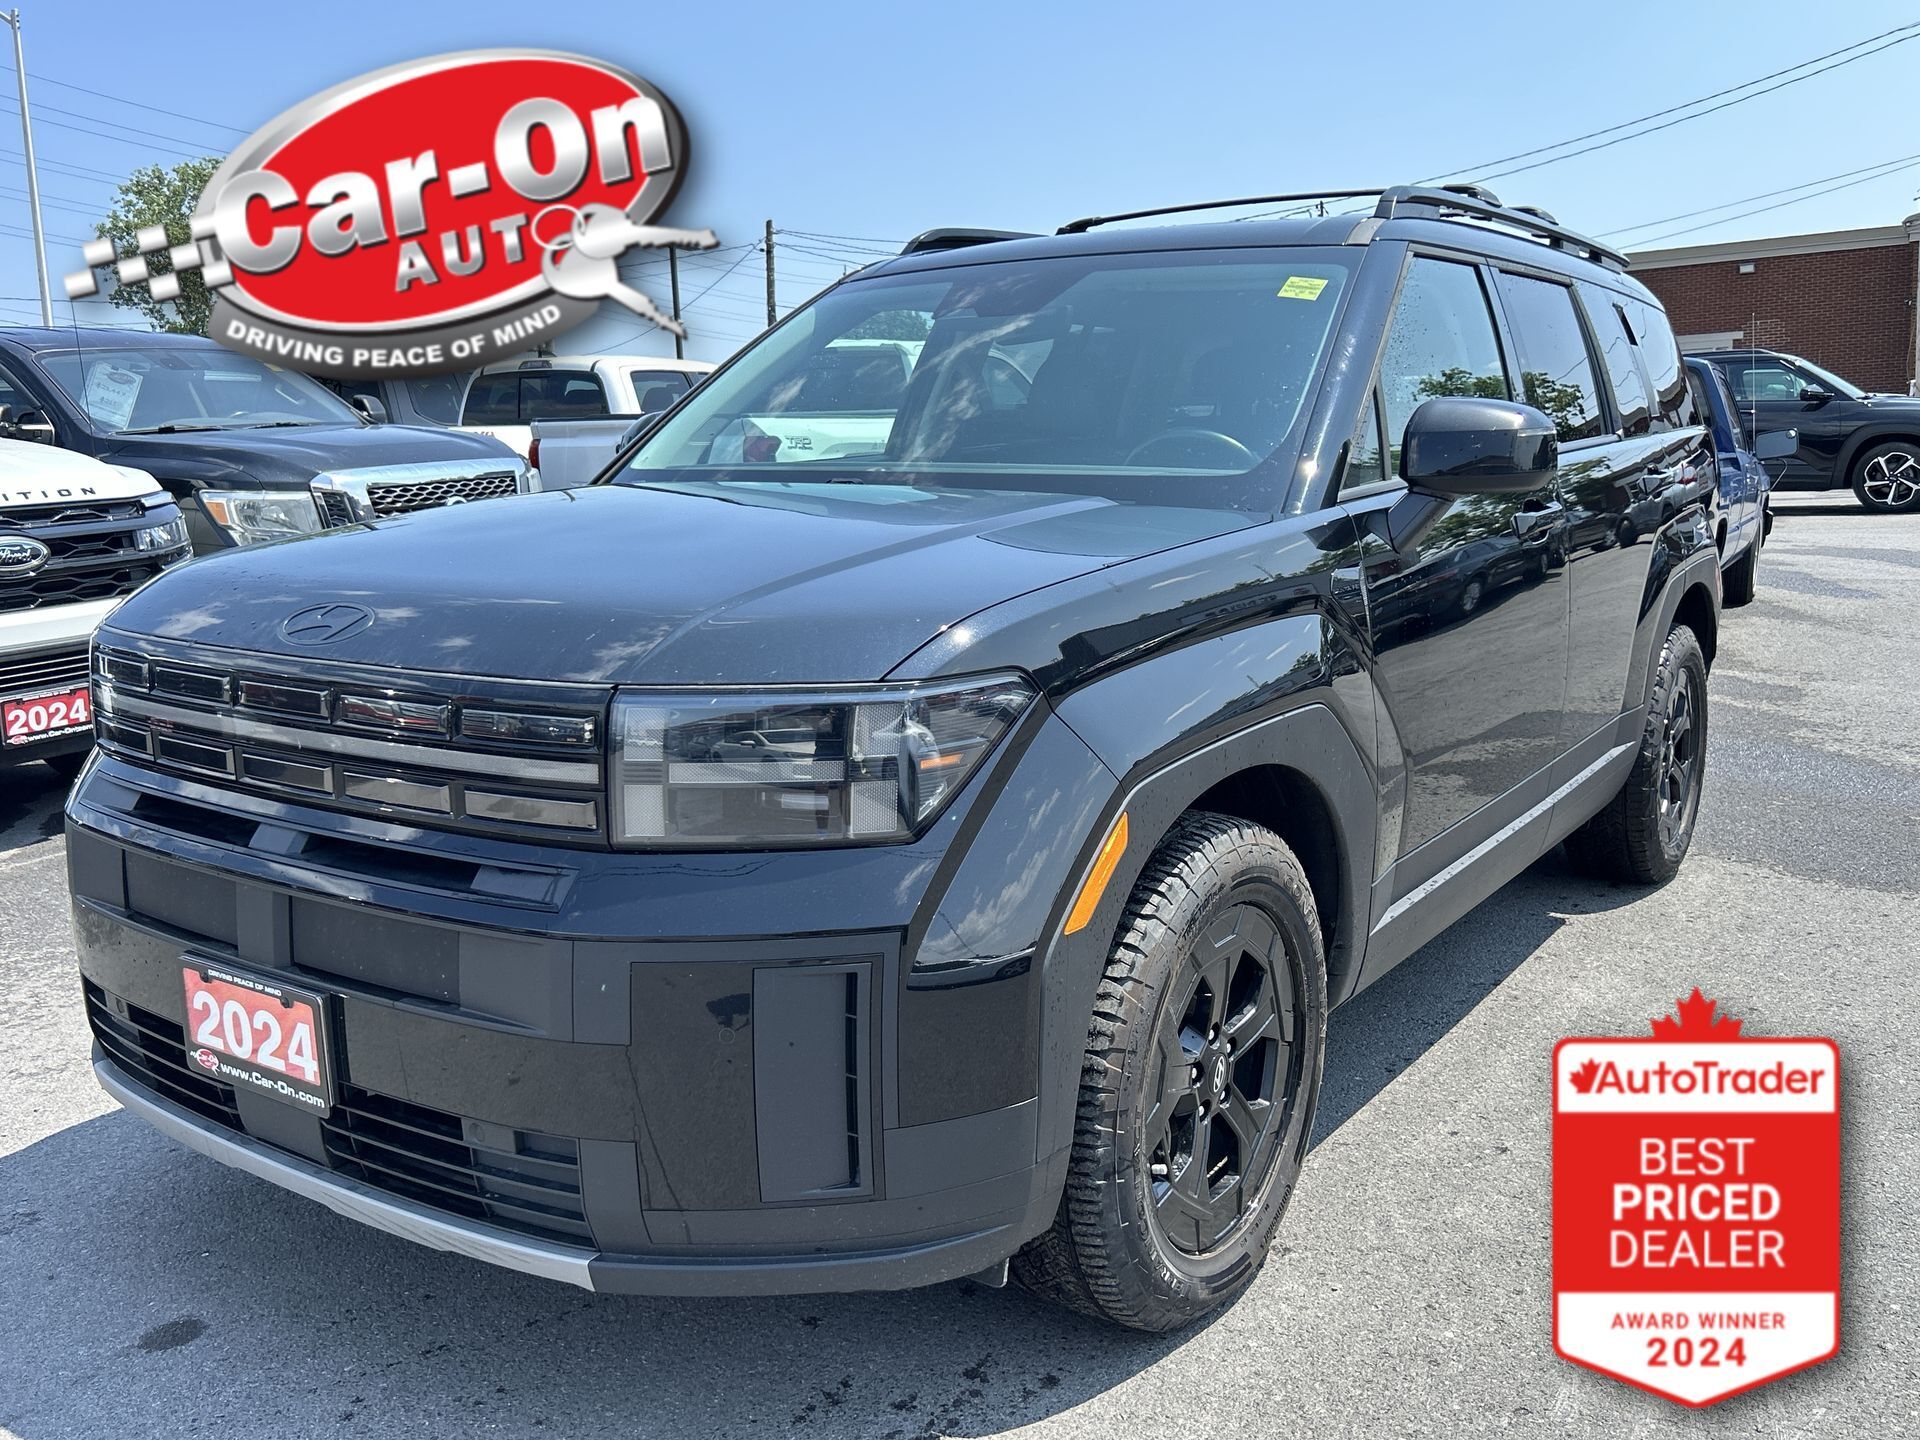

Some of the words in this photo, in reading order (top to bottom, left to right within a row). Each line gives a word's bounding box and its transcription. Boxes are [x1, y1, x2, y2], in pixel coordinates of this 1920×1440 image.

[7, 698, 88, 736] 2024
[193, 990, 319, 1082] 2024
[220, 1062, 325, 1109] www.Car-On.com
